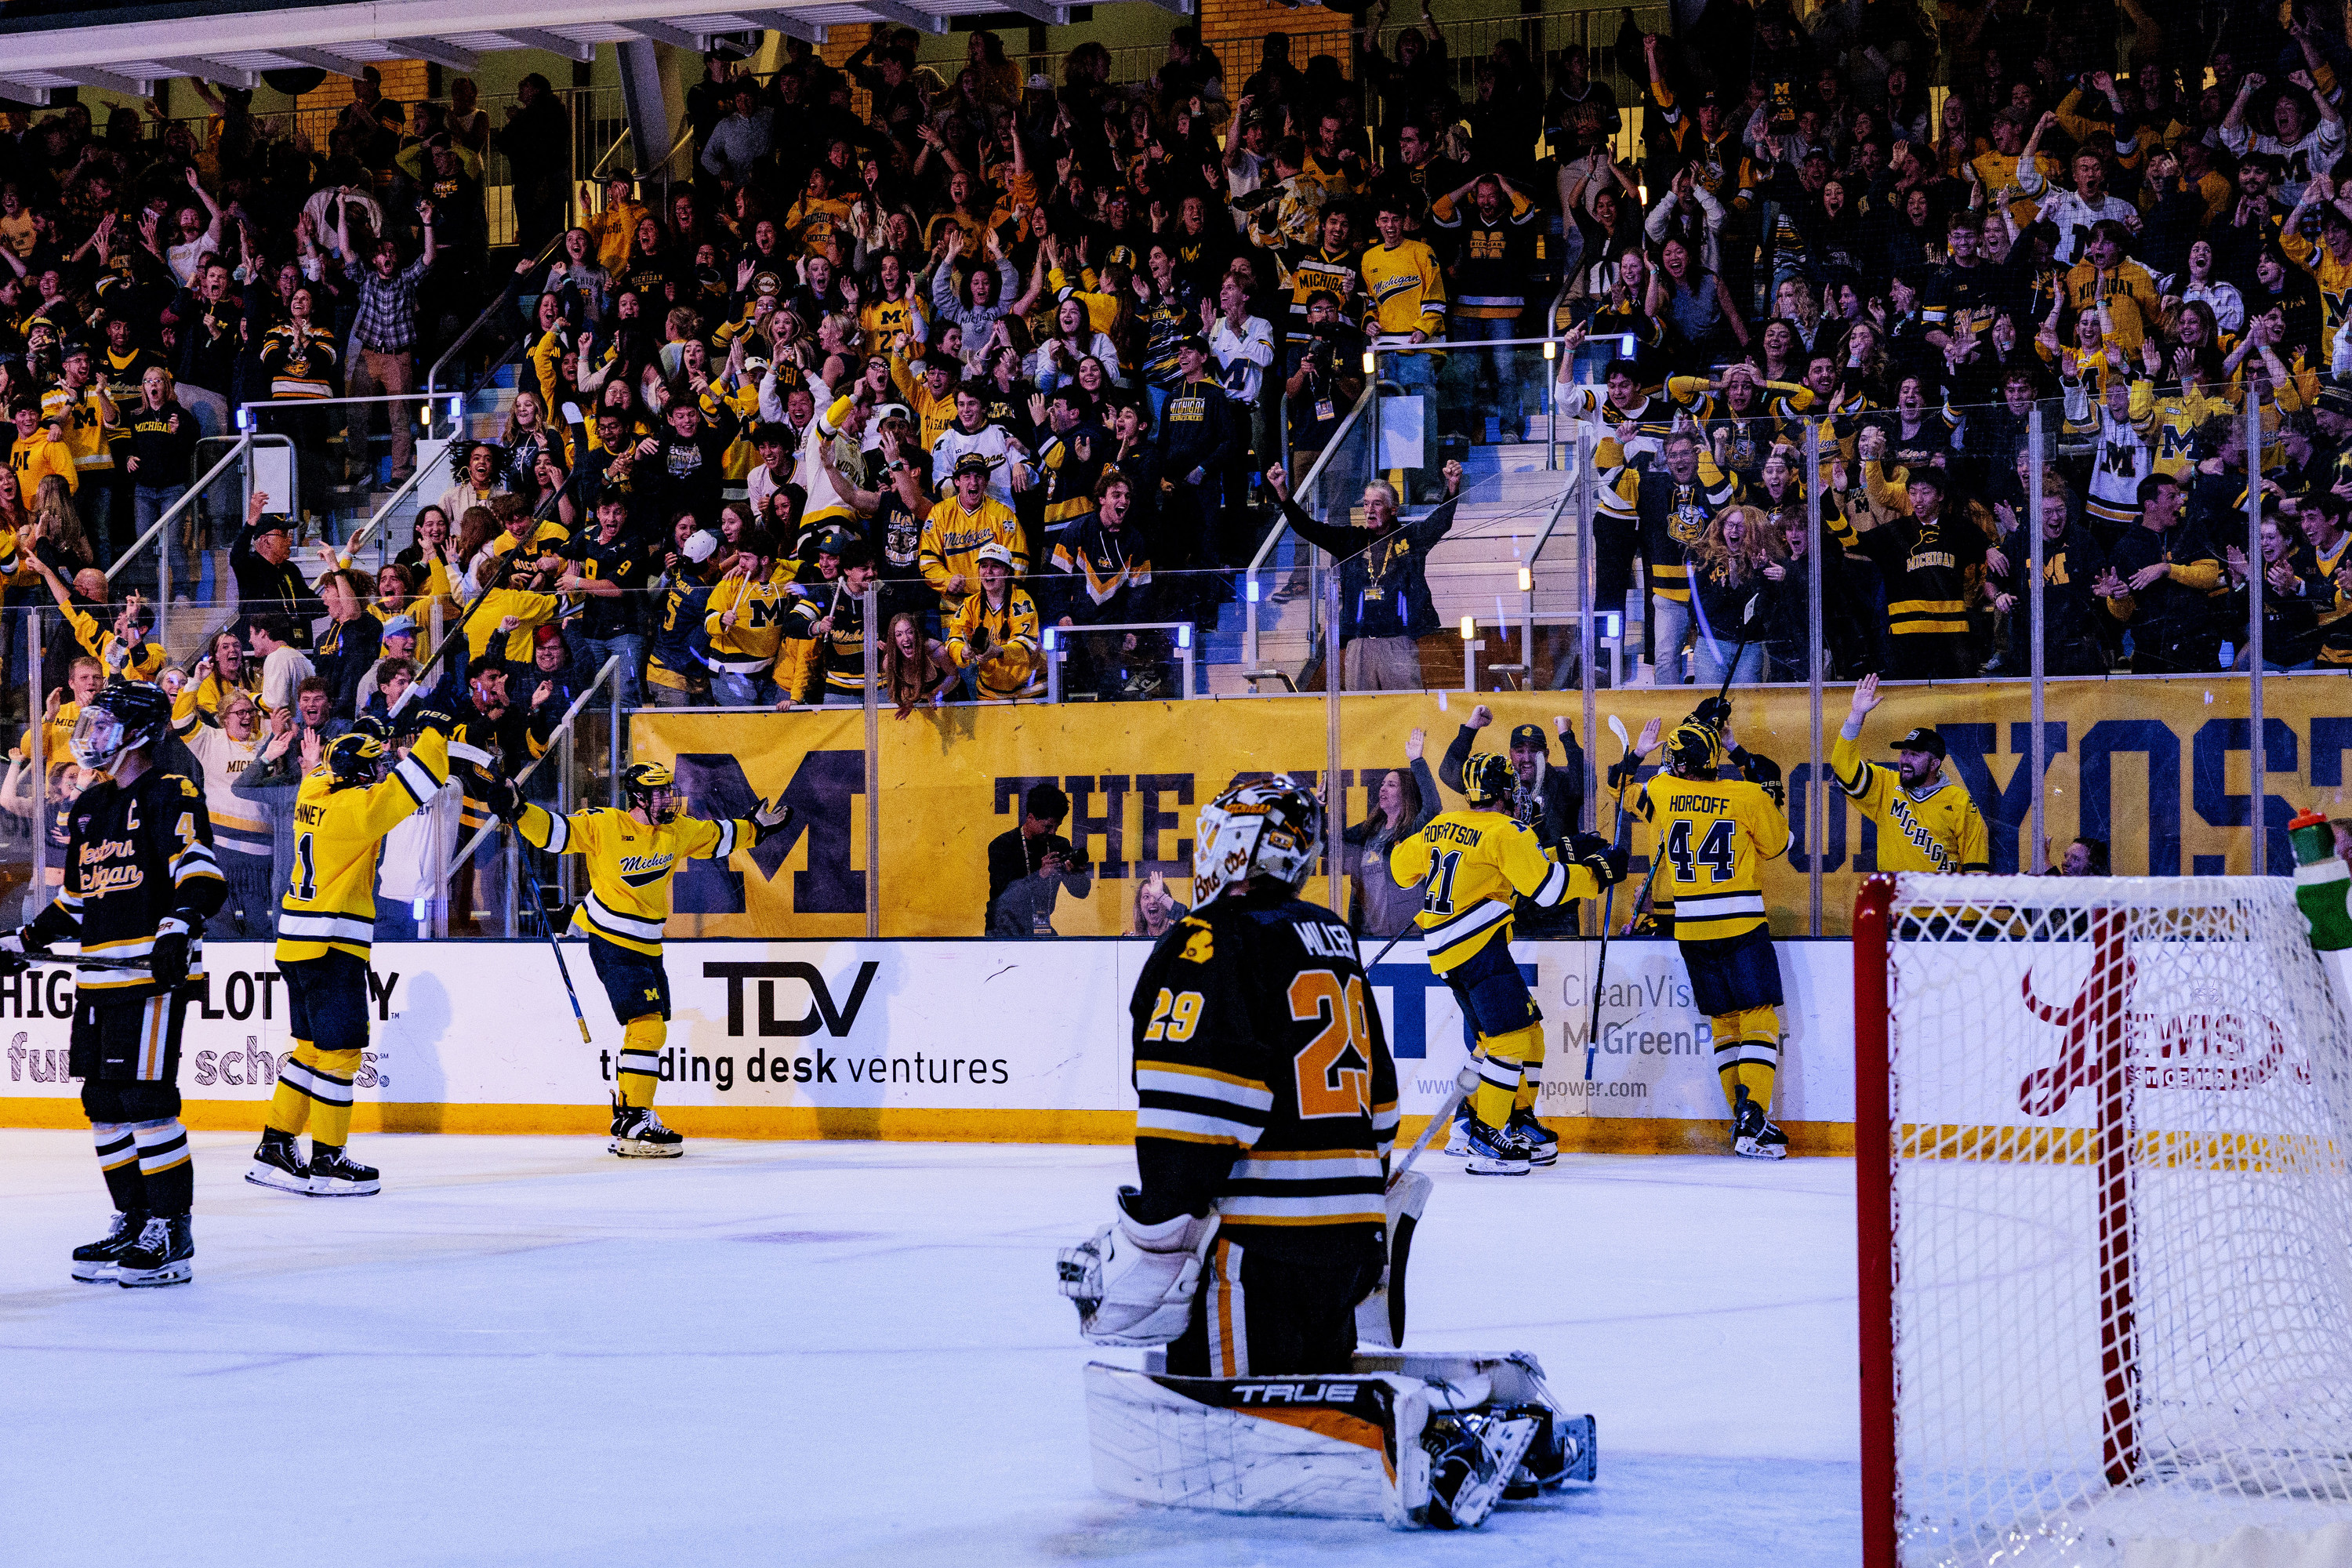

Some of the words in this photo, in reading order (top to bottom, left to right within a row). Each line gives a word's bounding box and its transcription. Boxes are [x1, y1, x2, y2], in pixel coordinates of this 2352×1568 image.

[1299, 274, 1345, 296] MICHIGA
[1373, 274, 1421, 296] Michigan
[2078, 278, 2133, 303] MICIGAN
[72, 407, 98, 430] M
[1170, 397, 1206, 415] MICHIGAN
[2161, 424, 2201, 461] M
[2100, 441, 2136, 477] M
[943, 526, 994, 548] Michigan
[1906, 551, 1955, 573] MICHIGAN
[662, 591, 683, 632] 5
[750, 598, 787, 628] M
[126, 798, 140, 830] C
[1669, 794, 1730, 815] HORCOFF
[174, 811, 197, 845] 4
[672, 750, 867, 913] M
[619, 851, 675, 873] Michiga
[1667, 818, 1736, 884] 44
[702, 961, 880, 1037] TDV
[1142, 987, 1206, 1043] 29
[1287, 968, 1374, 1120] 29
[747, 1047, 837, 1083] desk
[848, 1051, 1009, 1084] ventures
[1231, 1383, 1359, 1403] TRUE
